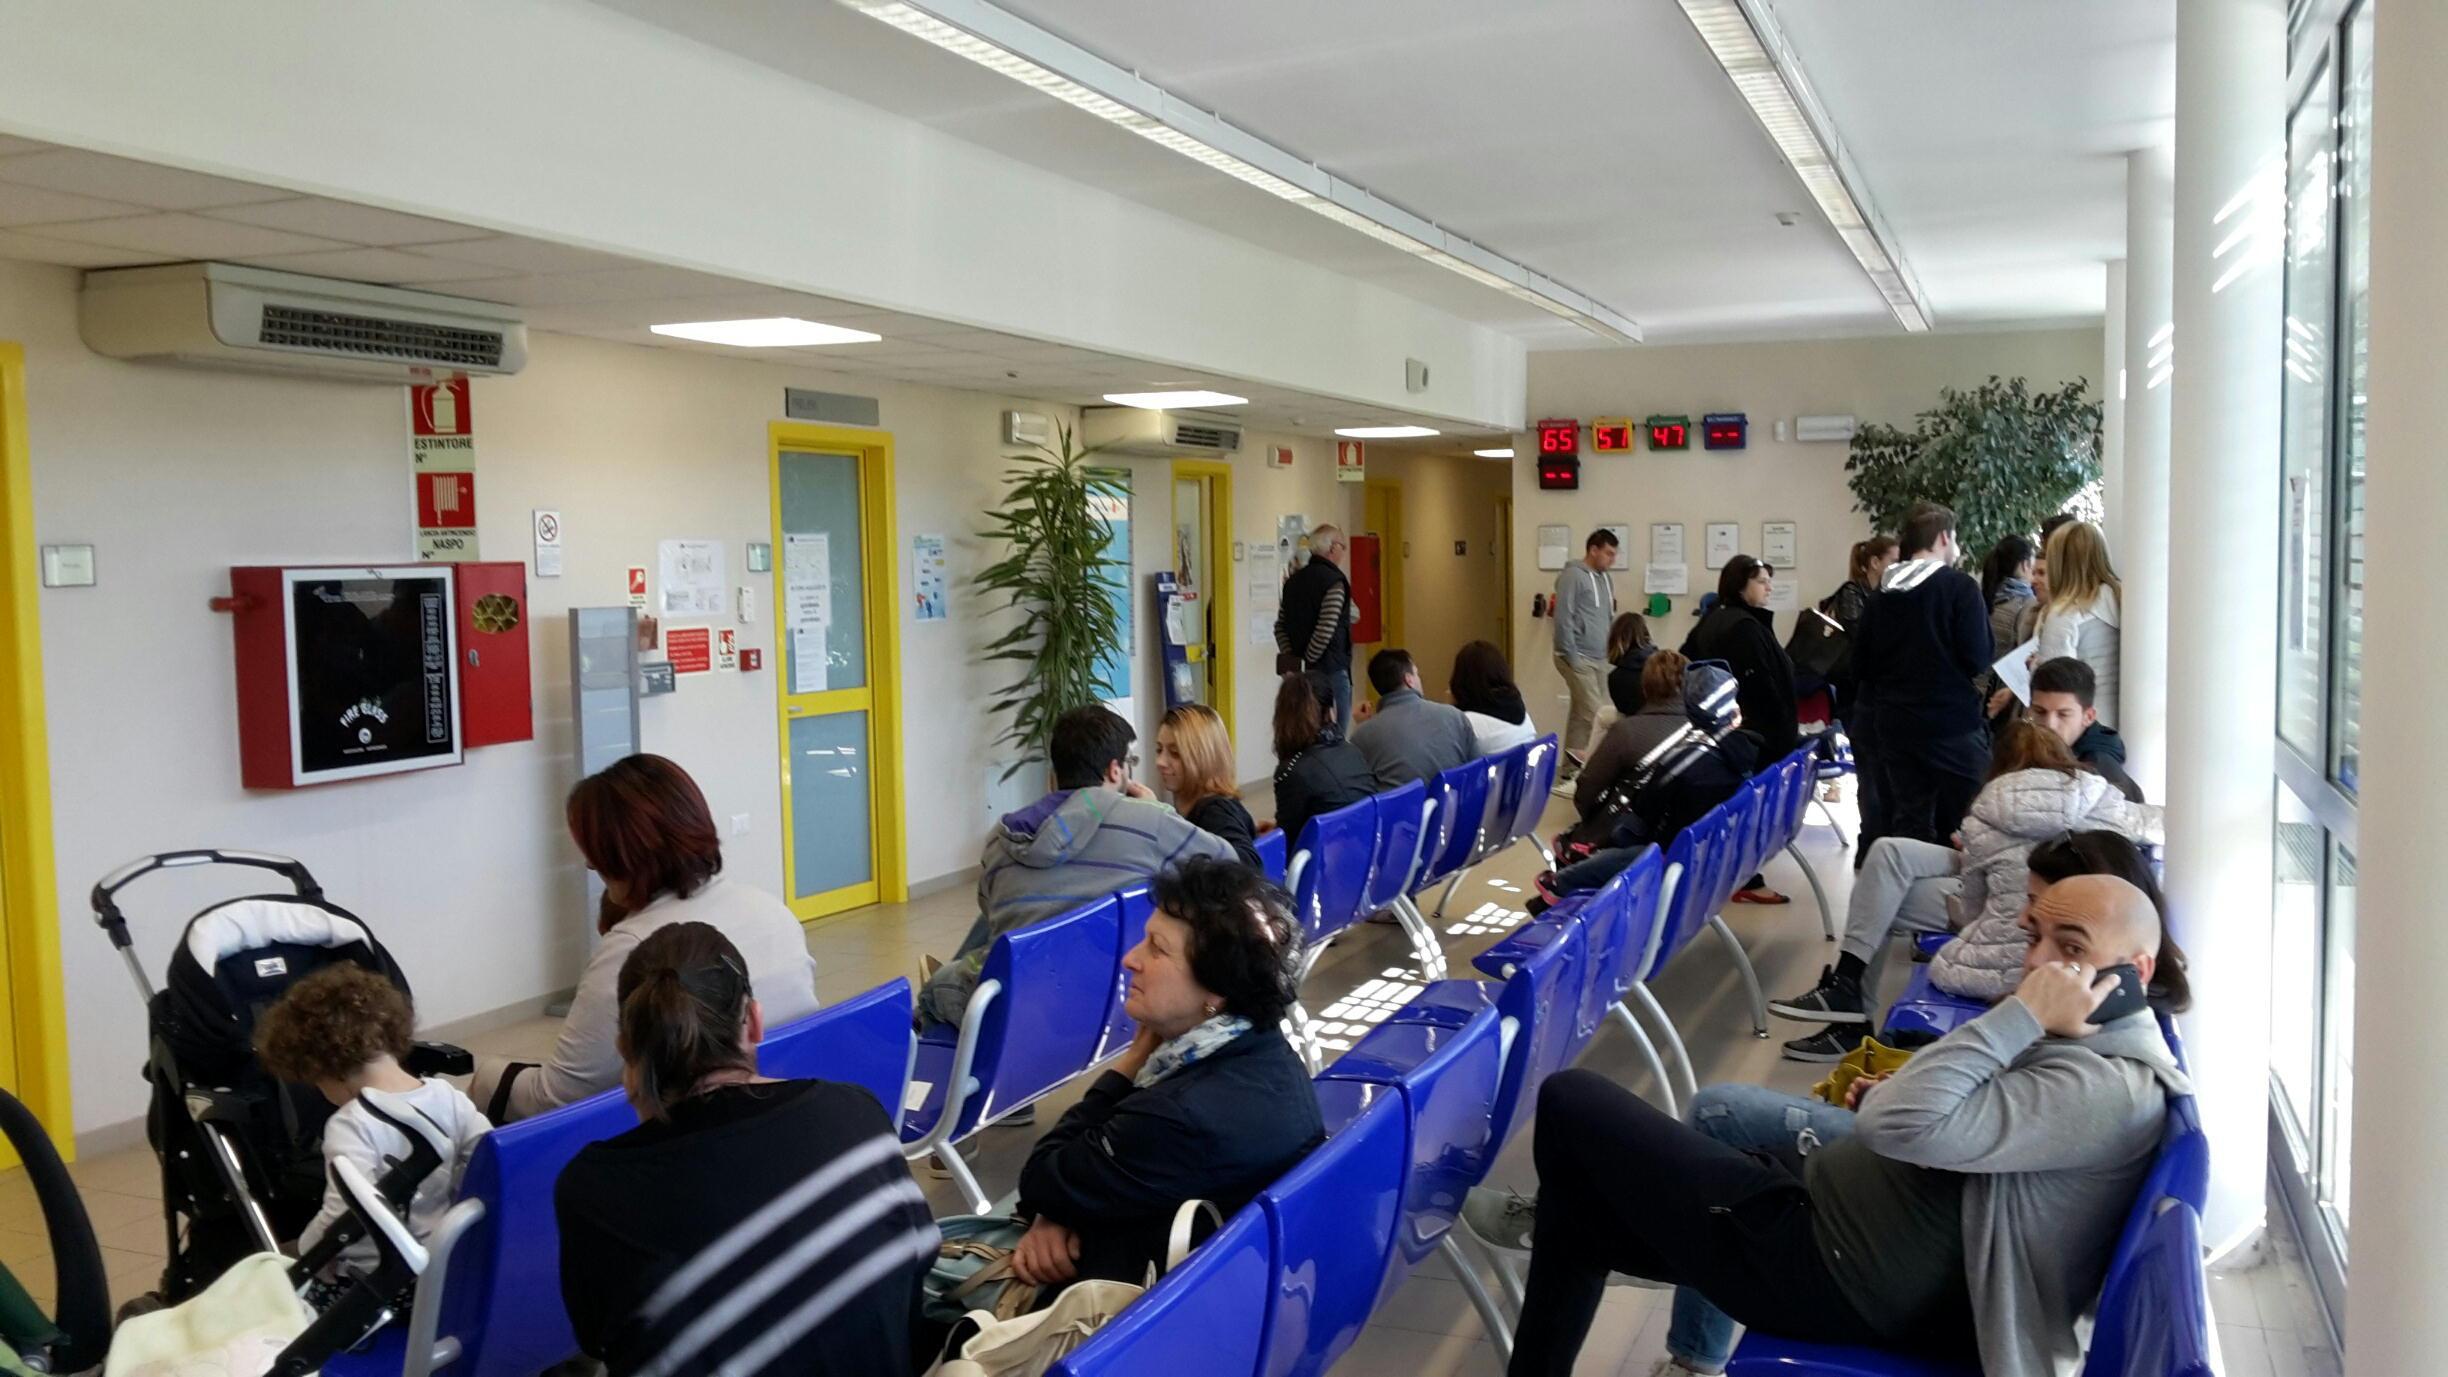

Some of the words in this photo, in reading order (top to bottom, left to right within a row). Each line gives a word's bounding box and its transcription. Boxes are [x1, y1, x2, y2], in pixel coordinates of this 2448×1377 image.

[414, 438, 473, 449] ESTINTORE
[1543, 429, 1572, 451] 65
[1598, 428, 1628, 449] 51
[1653, 425, 1685, 447] 47
[432, 538, 465, 549] NASPO
